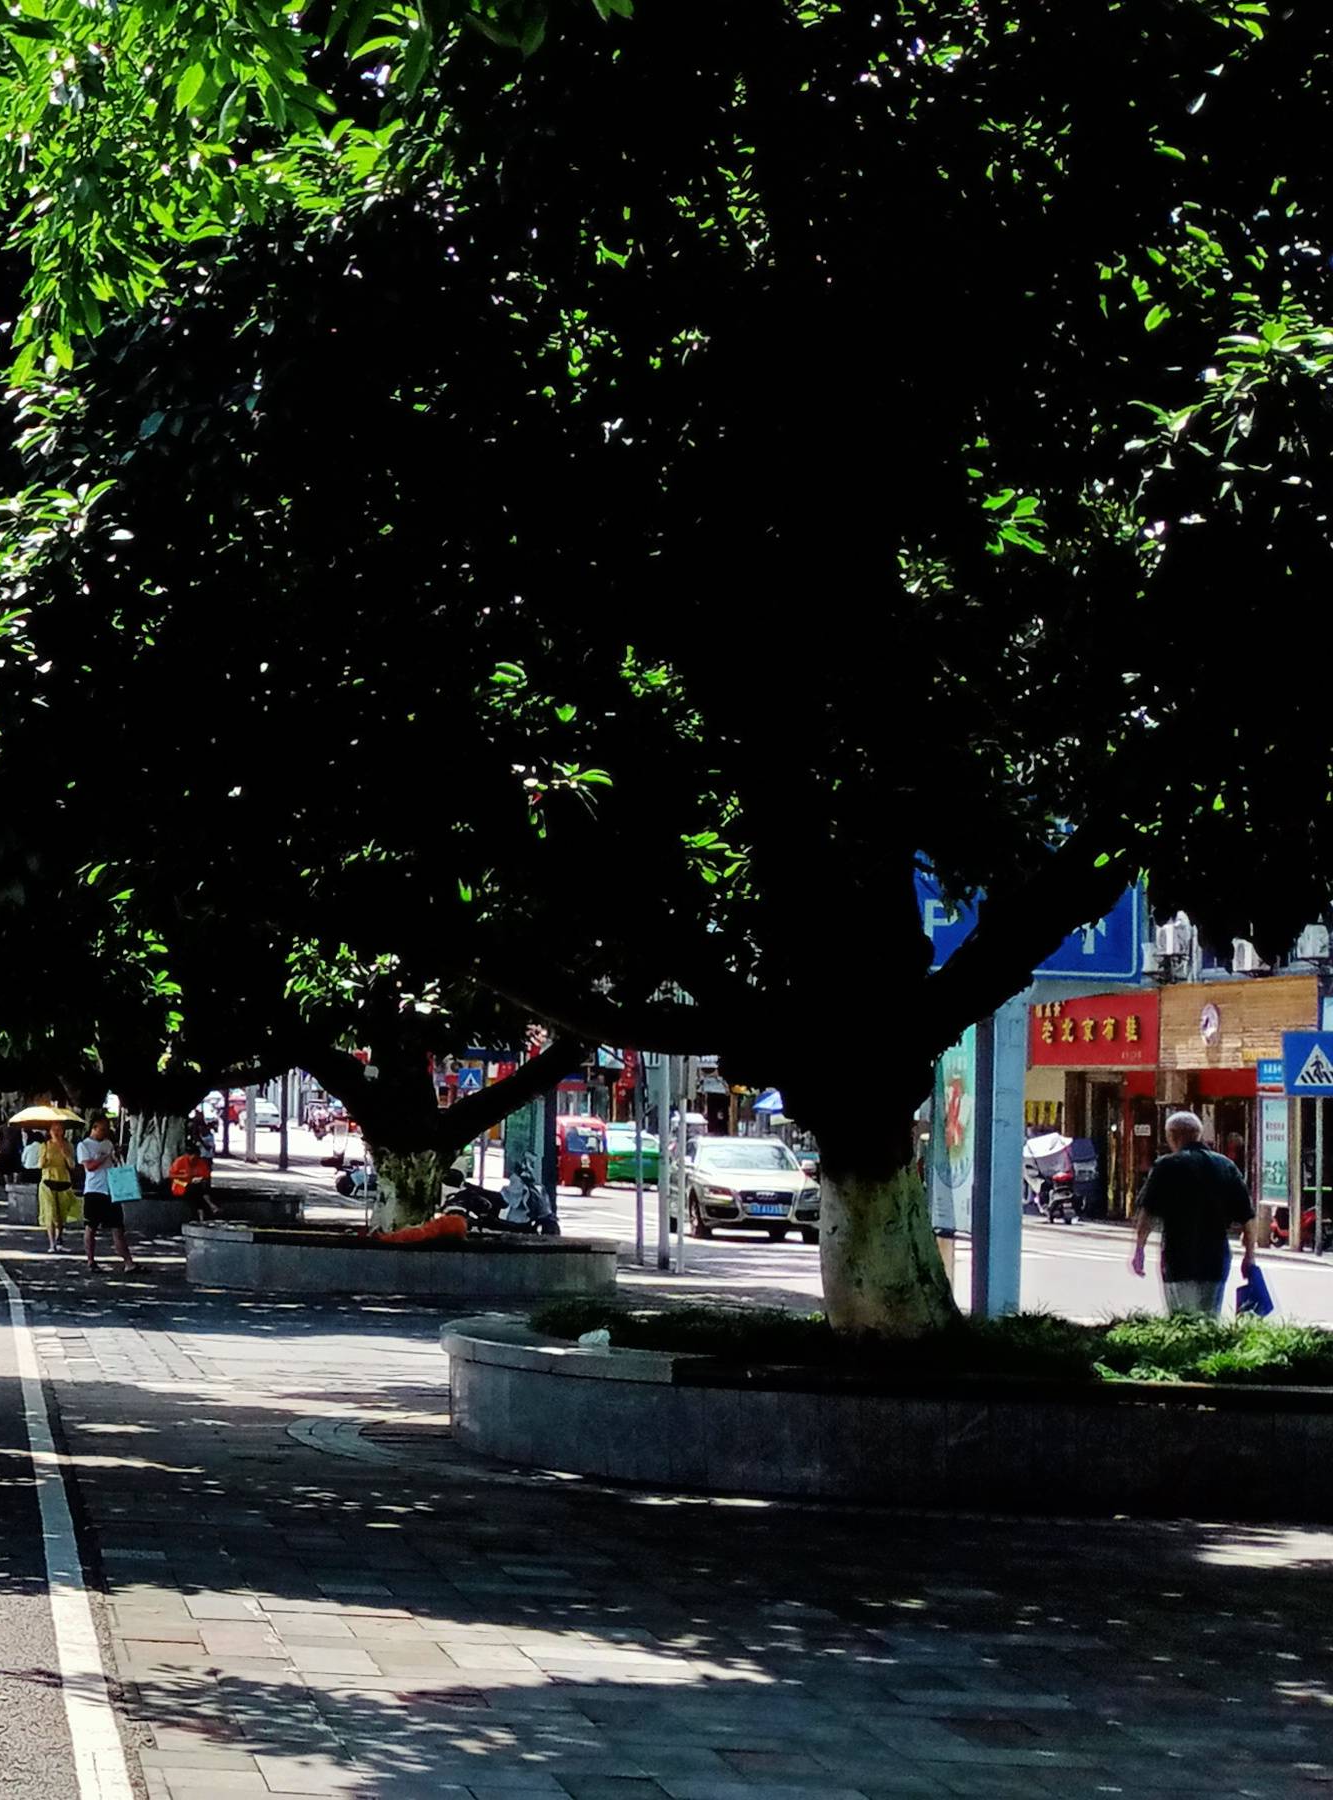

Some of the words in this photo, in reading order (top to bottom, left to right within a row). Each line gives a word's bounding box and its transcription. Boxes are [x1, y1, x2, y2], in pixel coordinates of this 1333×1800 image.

[924, 899, 958, 938] P
[1041, 1015, 1138, 1044] 老北京布鞋
